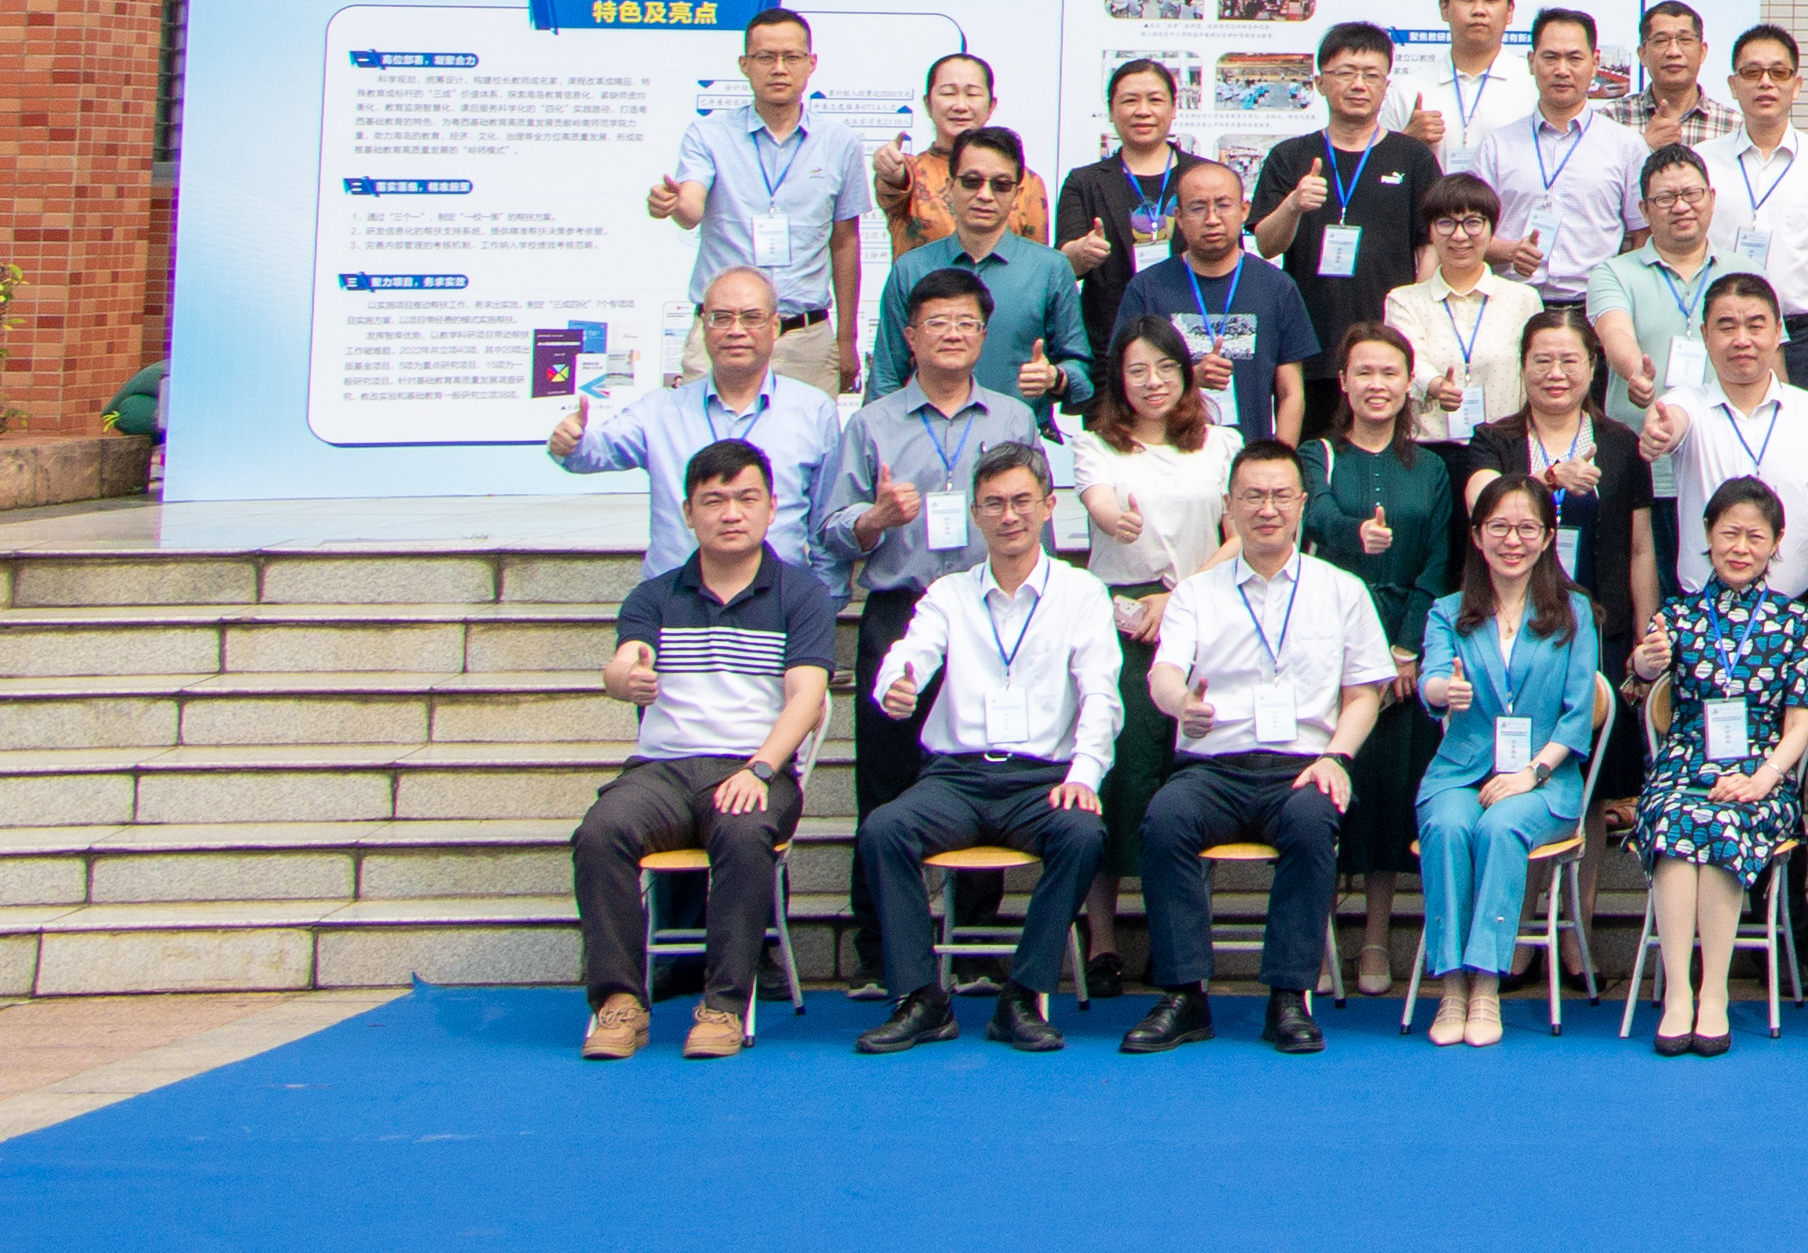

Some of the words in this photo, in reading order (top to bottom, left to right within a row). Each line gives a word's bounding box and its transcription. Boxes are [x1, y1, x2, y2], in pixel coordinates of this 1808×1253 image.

[592, 0, 718, 24] 特色及亮点
